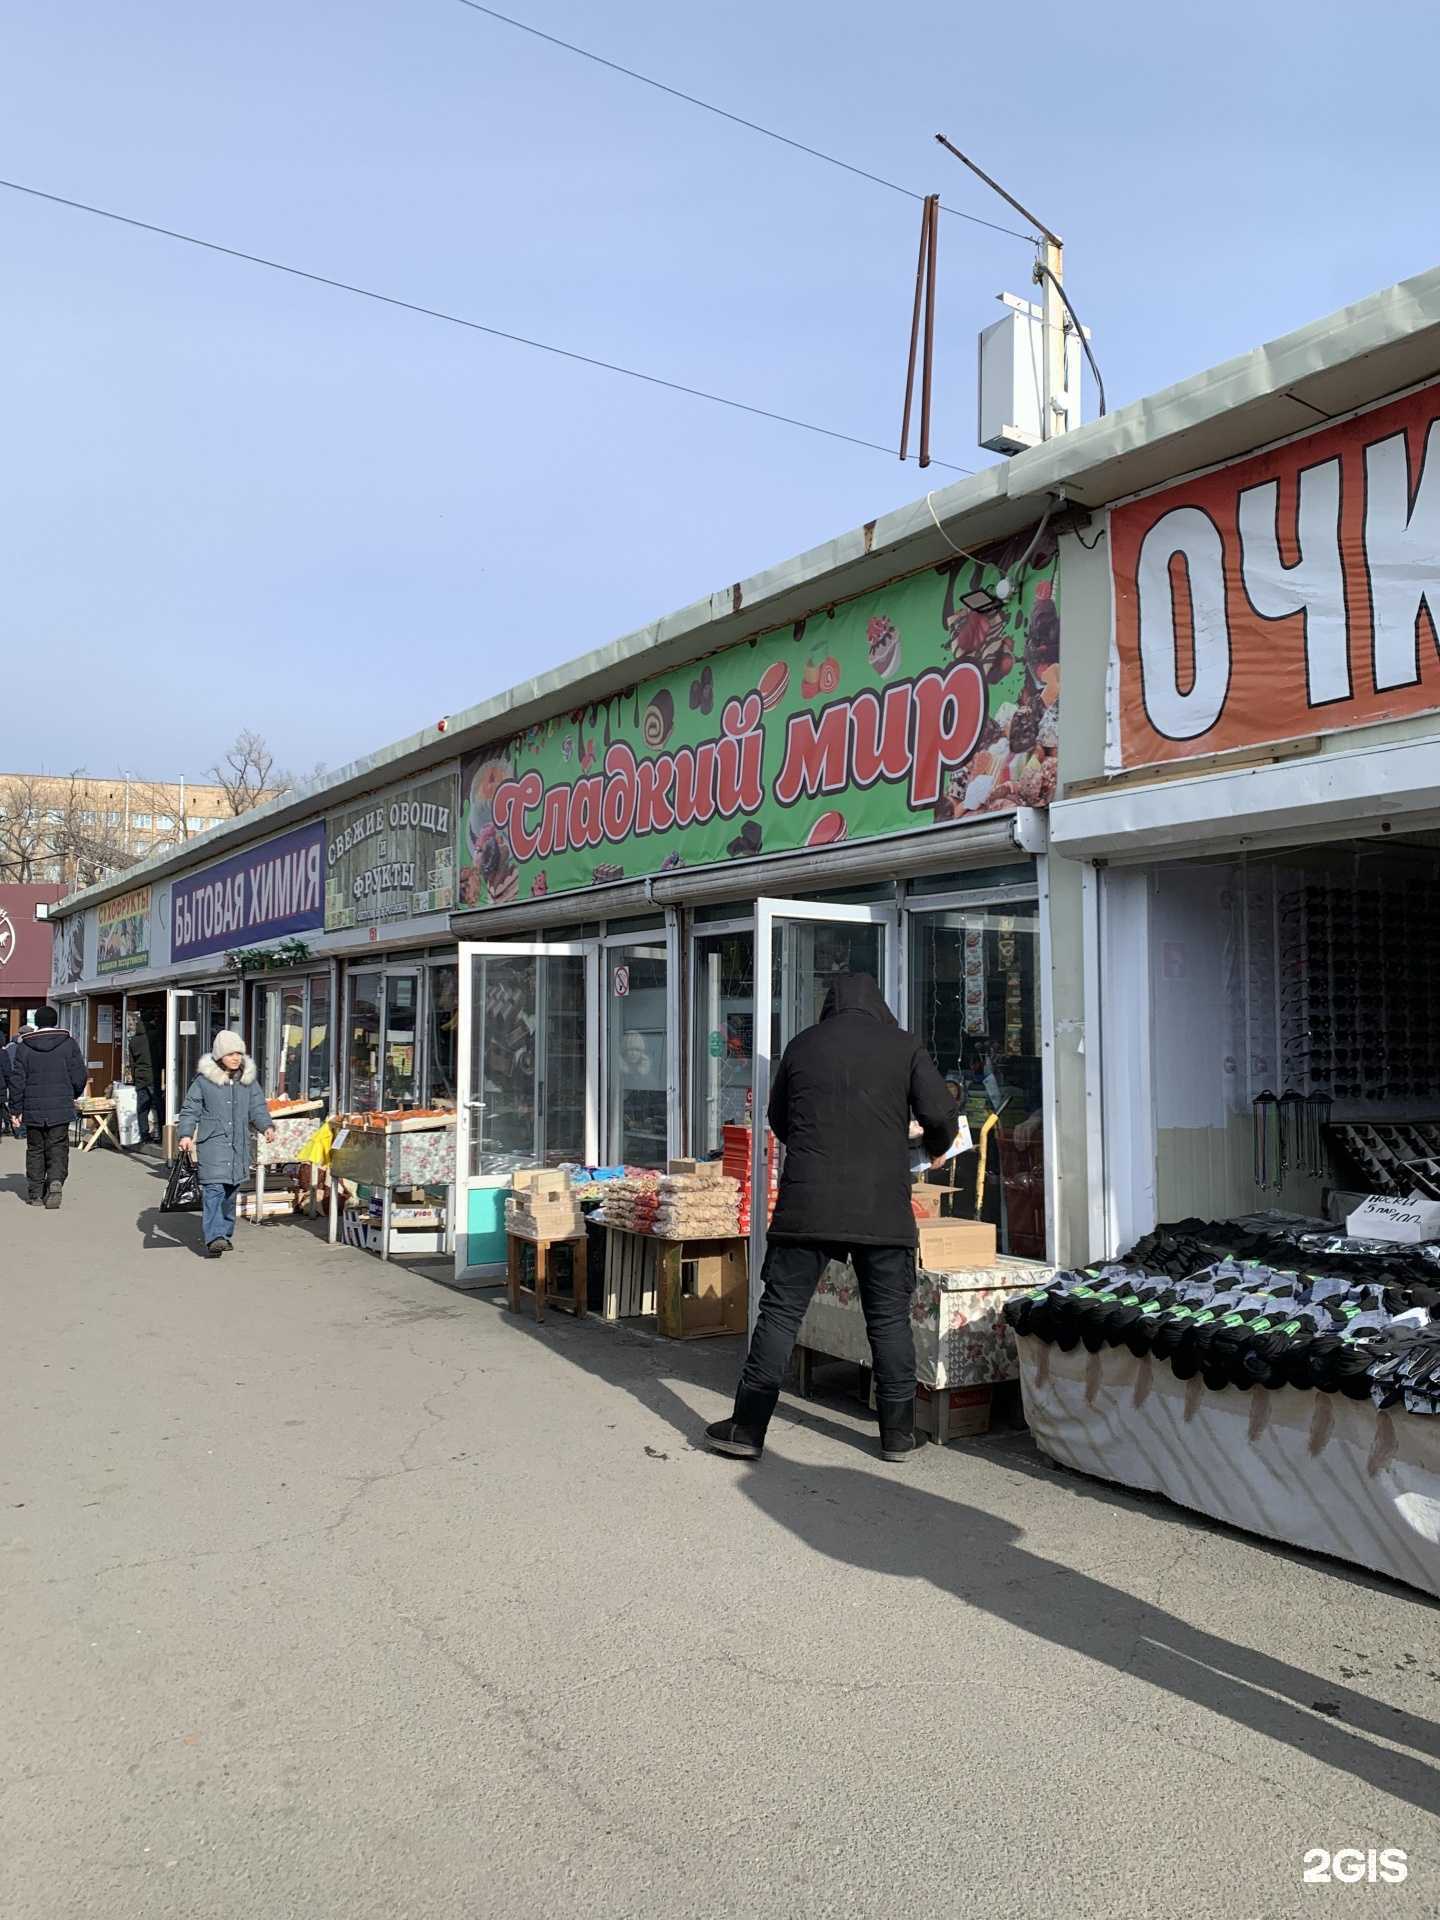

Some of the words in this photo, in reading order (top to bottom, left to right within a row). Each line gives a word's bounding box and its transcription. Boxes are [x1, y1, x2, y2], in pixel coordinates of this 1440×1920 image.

[491, 689, 764, 863] Сладкий
[776, 660, 987, 809] мир
[328, 807, 385, 865] СВЕЖИЕ
[389, 801, 450, 833] ОВОЩИ
[175, 872, 245, 947] БЫТОВАЯ
[248, 843, 321, 925] ХИМИЯ
[353, 863, 415, 898] ФРУКТЫ
